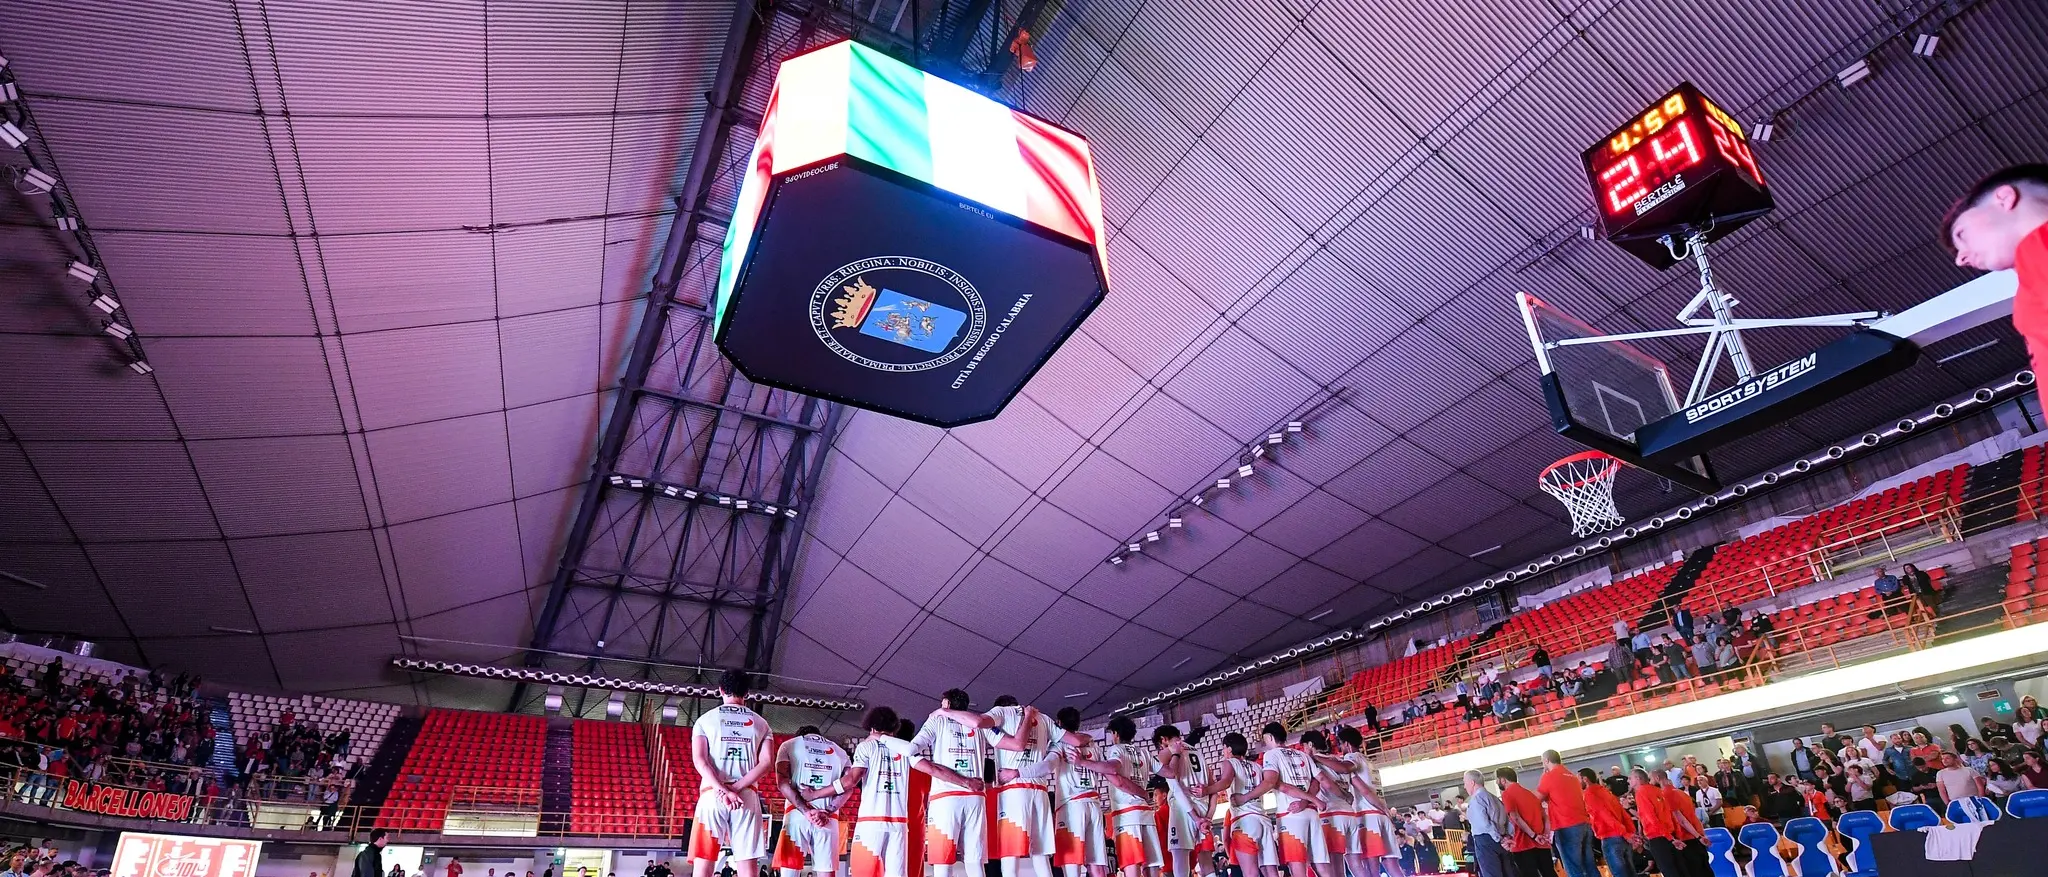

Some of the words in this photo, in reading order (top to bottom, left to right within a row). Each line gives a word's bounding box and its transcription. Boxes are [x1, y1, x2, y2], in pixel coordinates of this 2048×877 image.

[1611, 93, 1687, 153] 4:59
[784, 161, 839, 184] 360VIDEOCUBE
[1601, 121, 1701, 213] 24
[995, 293, 1034, 333] CALABRIA
[972, 332, 1001, 362] REGGIO
[951, 369, 973, 389] CITTÀ
[966, 360, 979, 371] DI
[1685, 352, 1817, 424] SPORTSYSTEM
[1189, 753, 1201, 773] 9
[63, 779, 195, 821] BARCELLONESI
